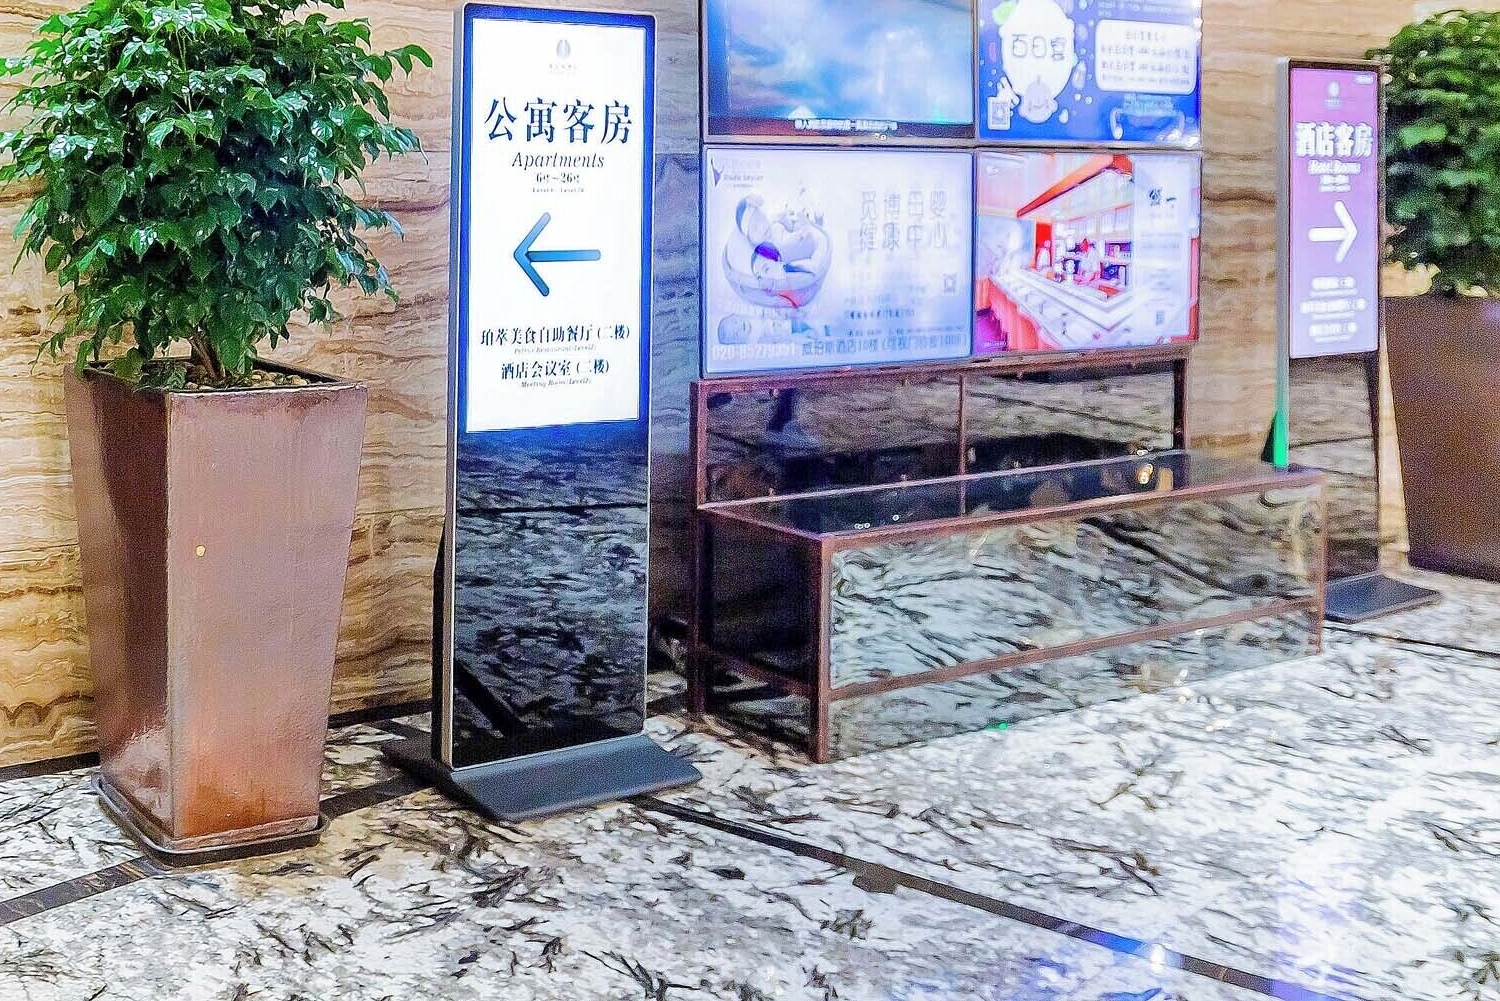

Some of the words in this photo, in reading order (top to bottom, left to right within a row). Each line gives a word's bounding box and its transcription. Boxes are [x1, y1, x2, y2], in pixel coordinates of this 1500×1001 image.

[484, 96, 633, 145] 公寓客房
[1295, 121, 1373, 158] 酒店客房
[511, 152, 605, 171] Apartments
